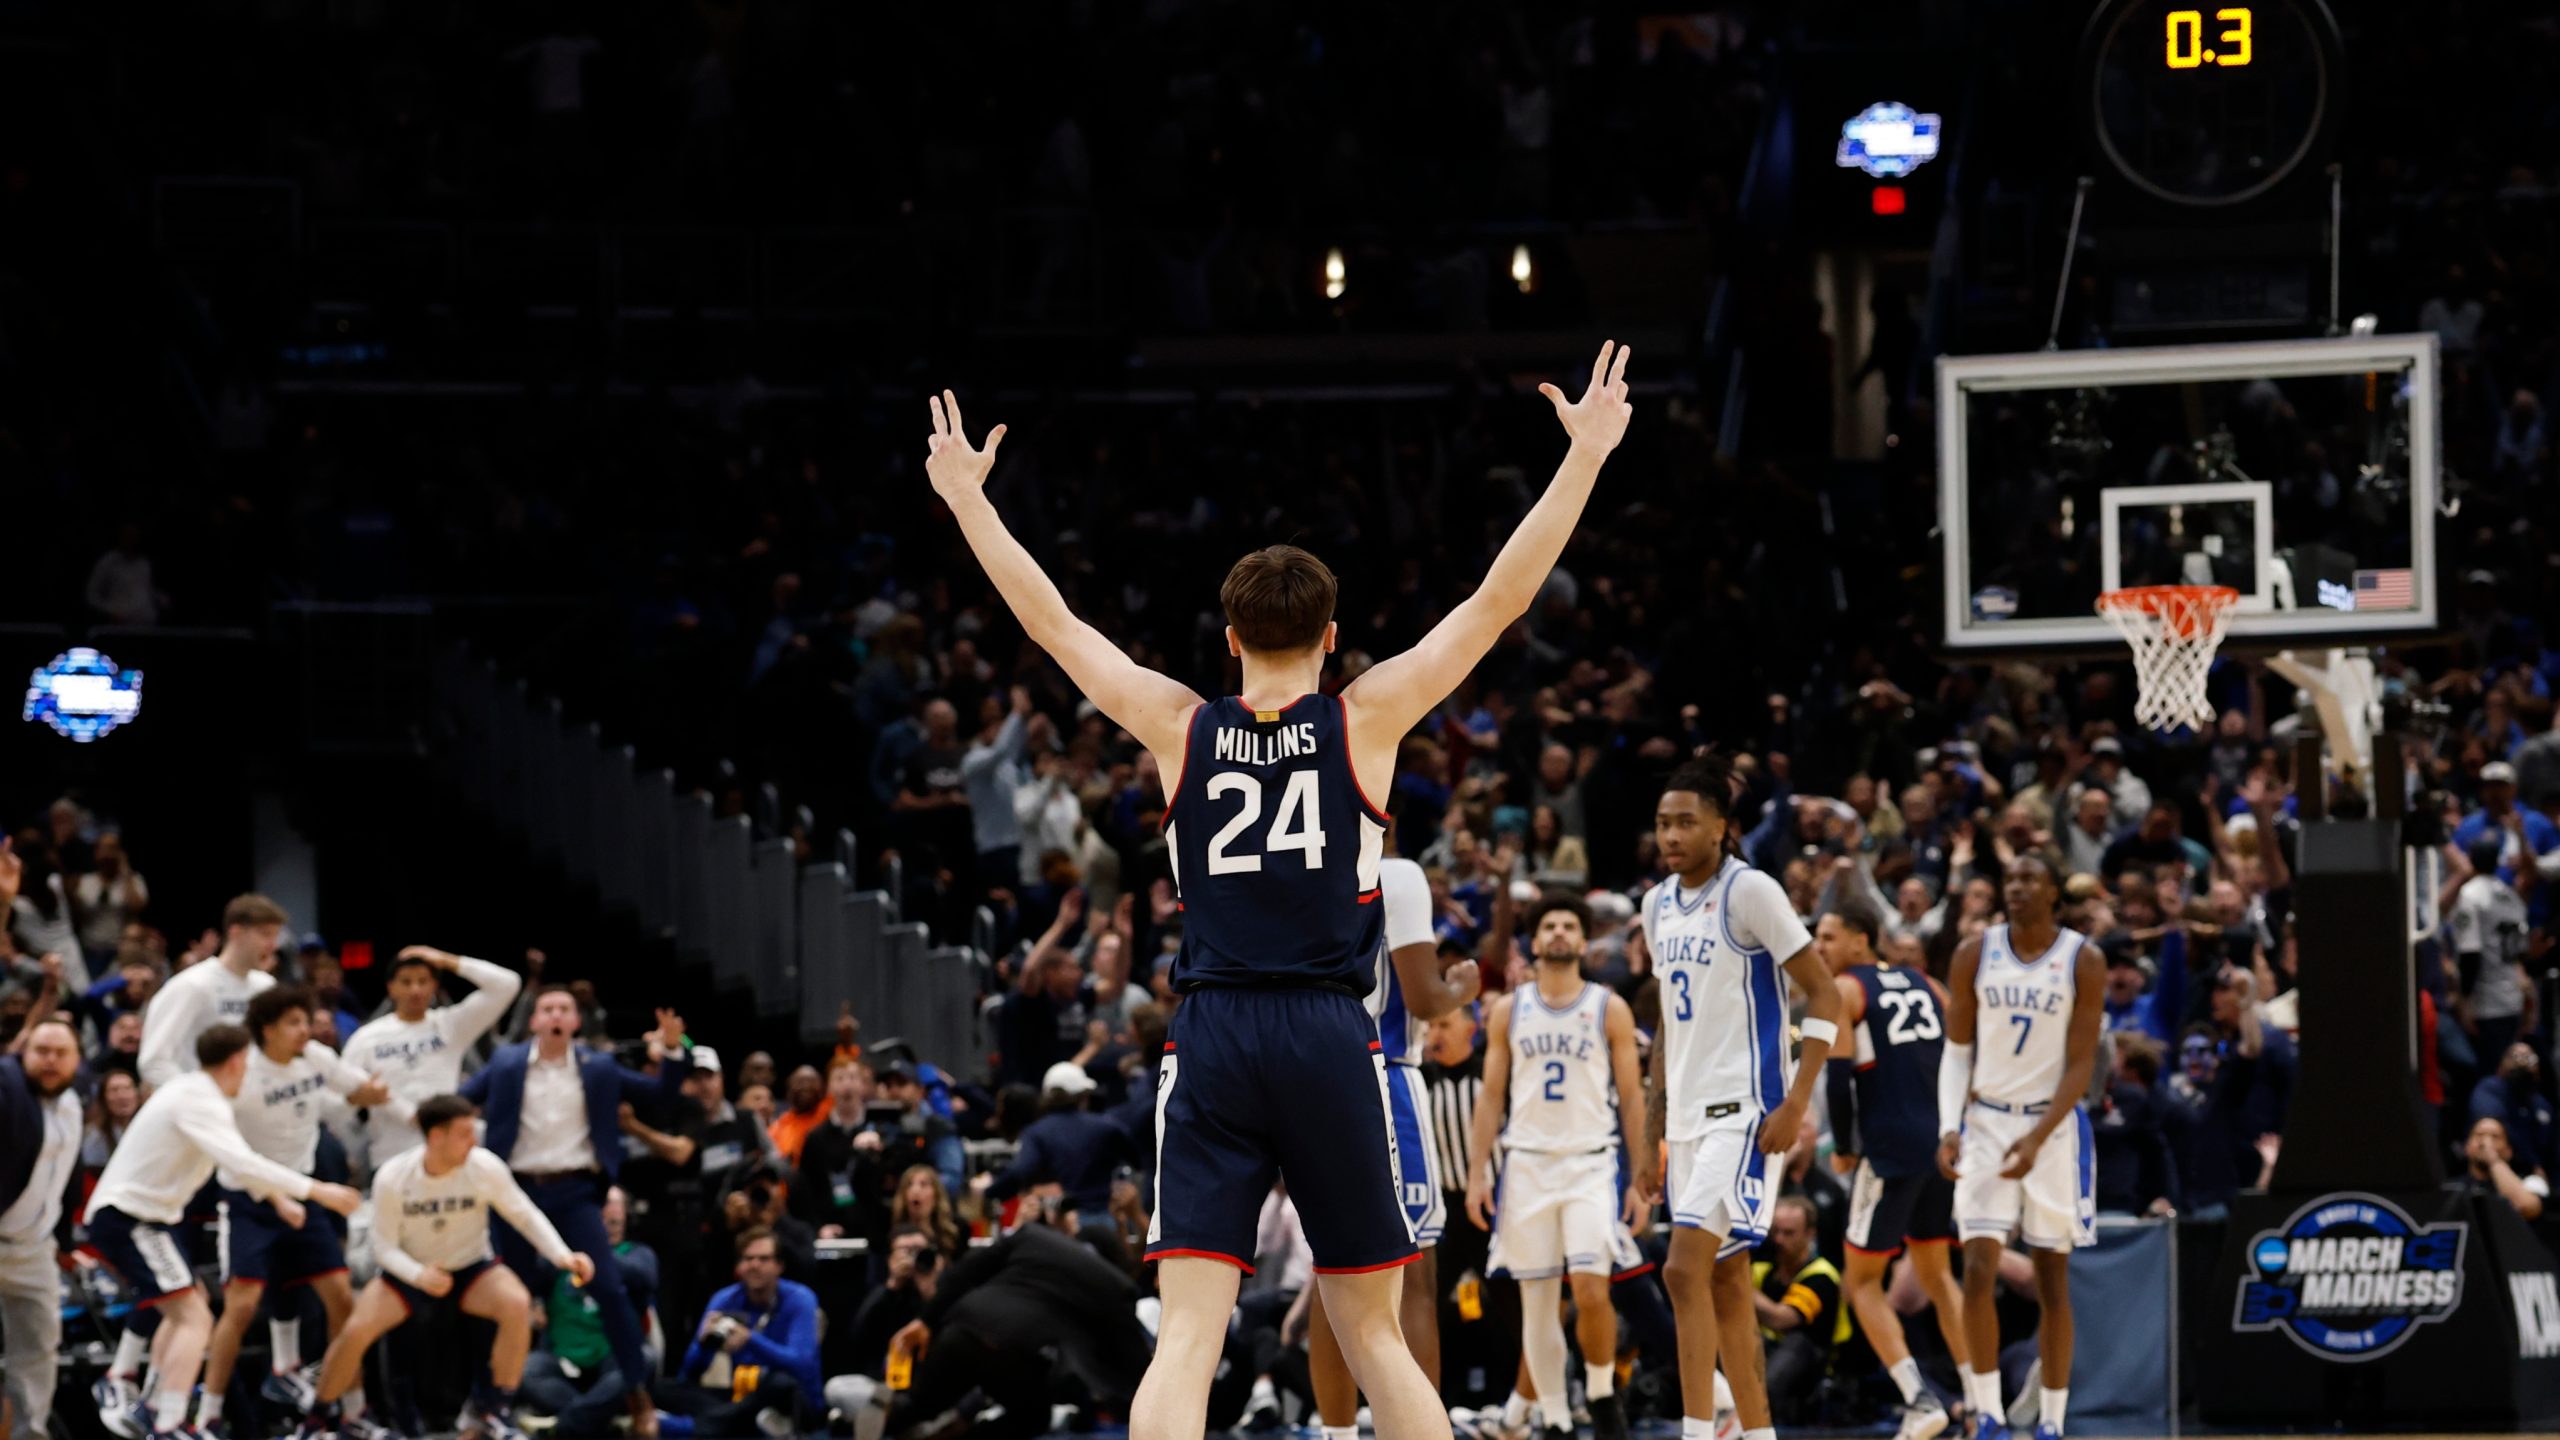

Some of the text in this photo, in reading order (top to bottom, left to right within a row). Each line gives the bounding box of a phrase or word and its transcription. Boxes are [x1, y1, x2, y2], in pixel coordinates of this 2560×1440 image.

[2167, 8, 2251, 68] 0.3
[1215, 722, 1317, 766] MULLINS
[1207, 769, 1326, 875] 24
[1671, 969, 1693, 1022] 3
[1984, 985, 2063, 1015] DUKE
[1878, 989, 1942, 1045] 23
[2011, 1014, 2032, 1055] 7
[1519, 1033, 1594, 1061] DUKE
[1545, 1061, 1565, 1101] 2
[2287, 1237, 2404, 1273] MARCH
[2301, 1270, 2456, 1308] MADNESS
